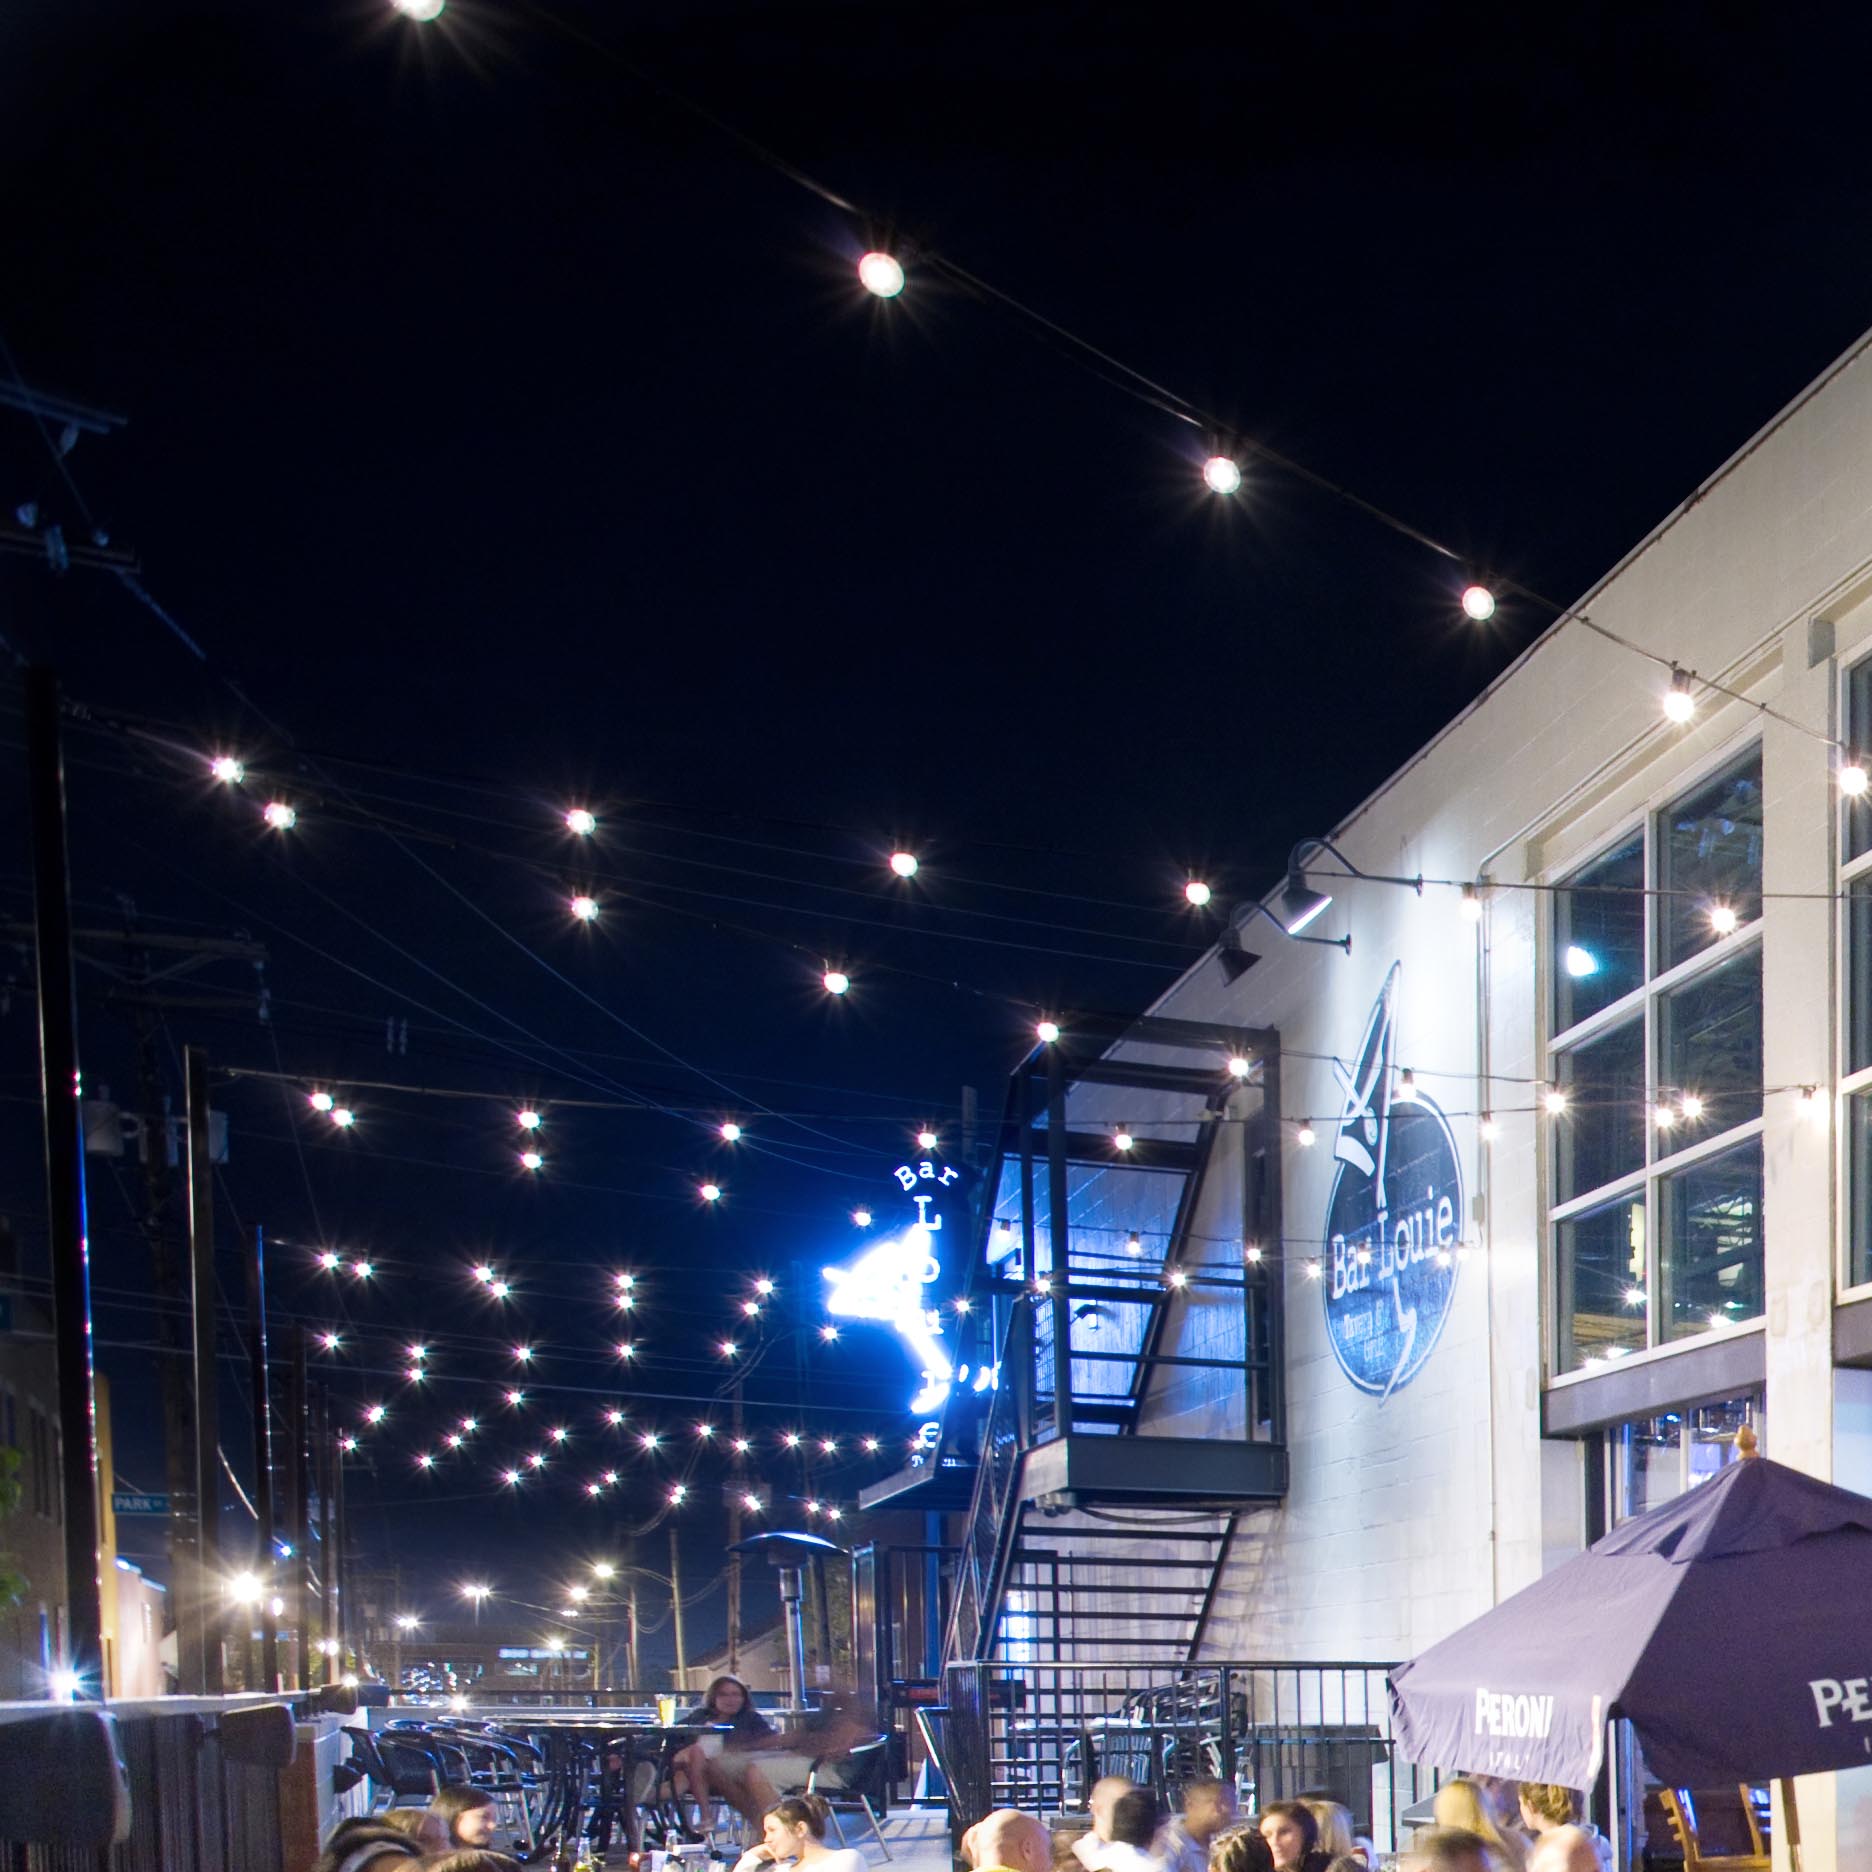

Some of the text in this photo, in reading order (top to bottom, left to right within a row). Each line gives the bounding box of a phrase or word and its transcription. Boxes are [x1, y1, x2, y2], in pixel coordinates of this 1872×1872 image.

[893, 1161, 959, 1191] Bar
[1377, 1184, 1454, 1281] Louie
[114, 1495, 153, 1512] PARK
[1474, 1687, 1555, 1739] PERONI
